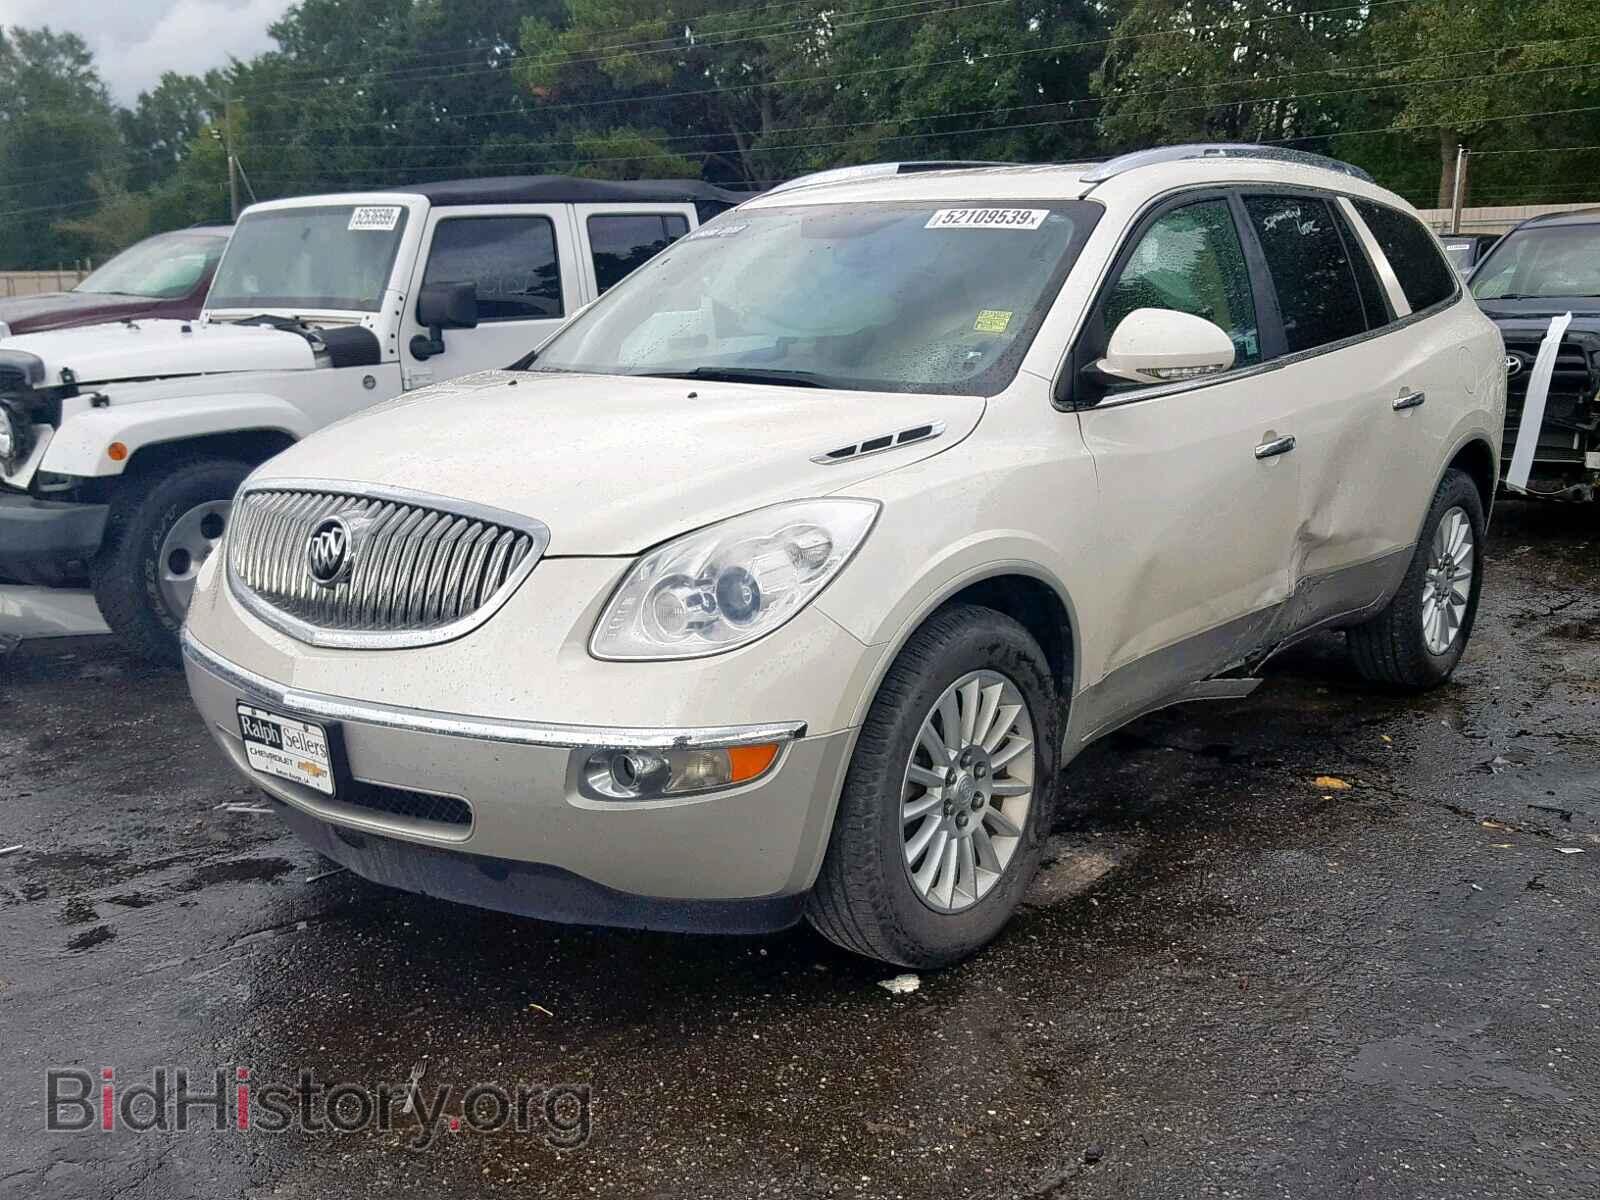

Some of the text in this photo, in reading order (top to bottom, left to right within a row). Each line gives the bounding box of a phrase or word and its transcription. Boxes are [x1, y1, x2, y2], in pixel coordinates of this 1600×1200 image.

[241, 716, 327, 758] Ralph Sellers
[249, 747, 293, 766] CHEVROLET
